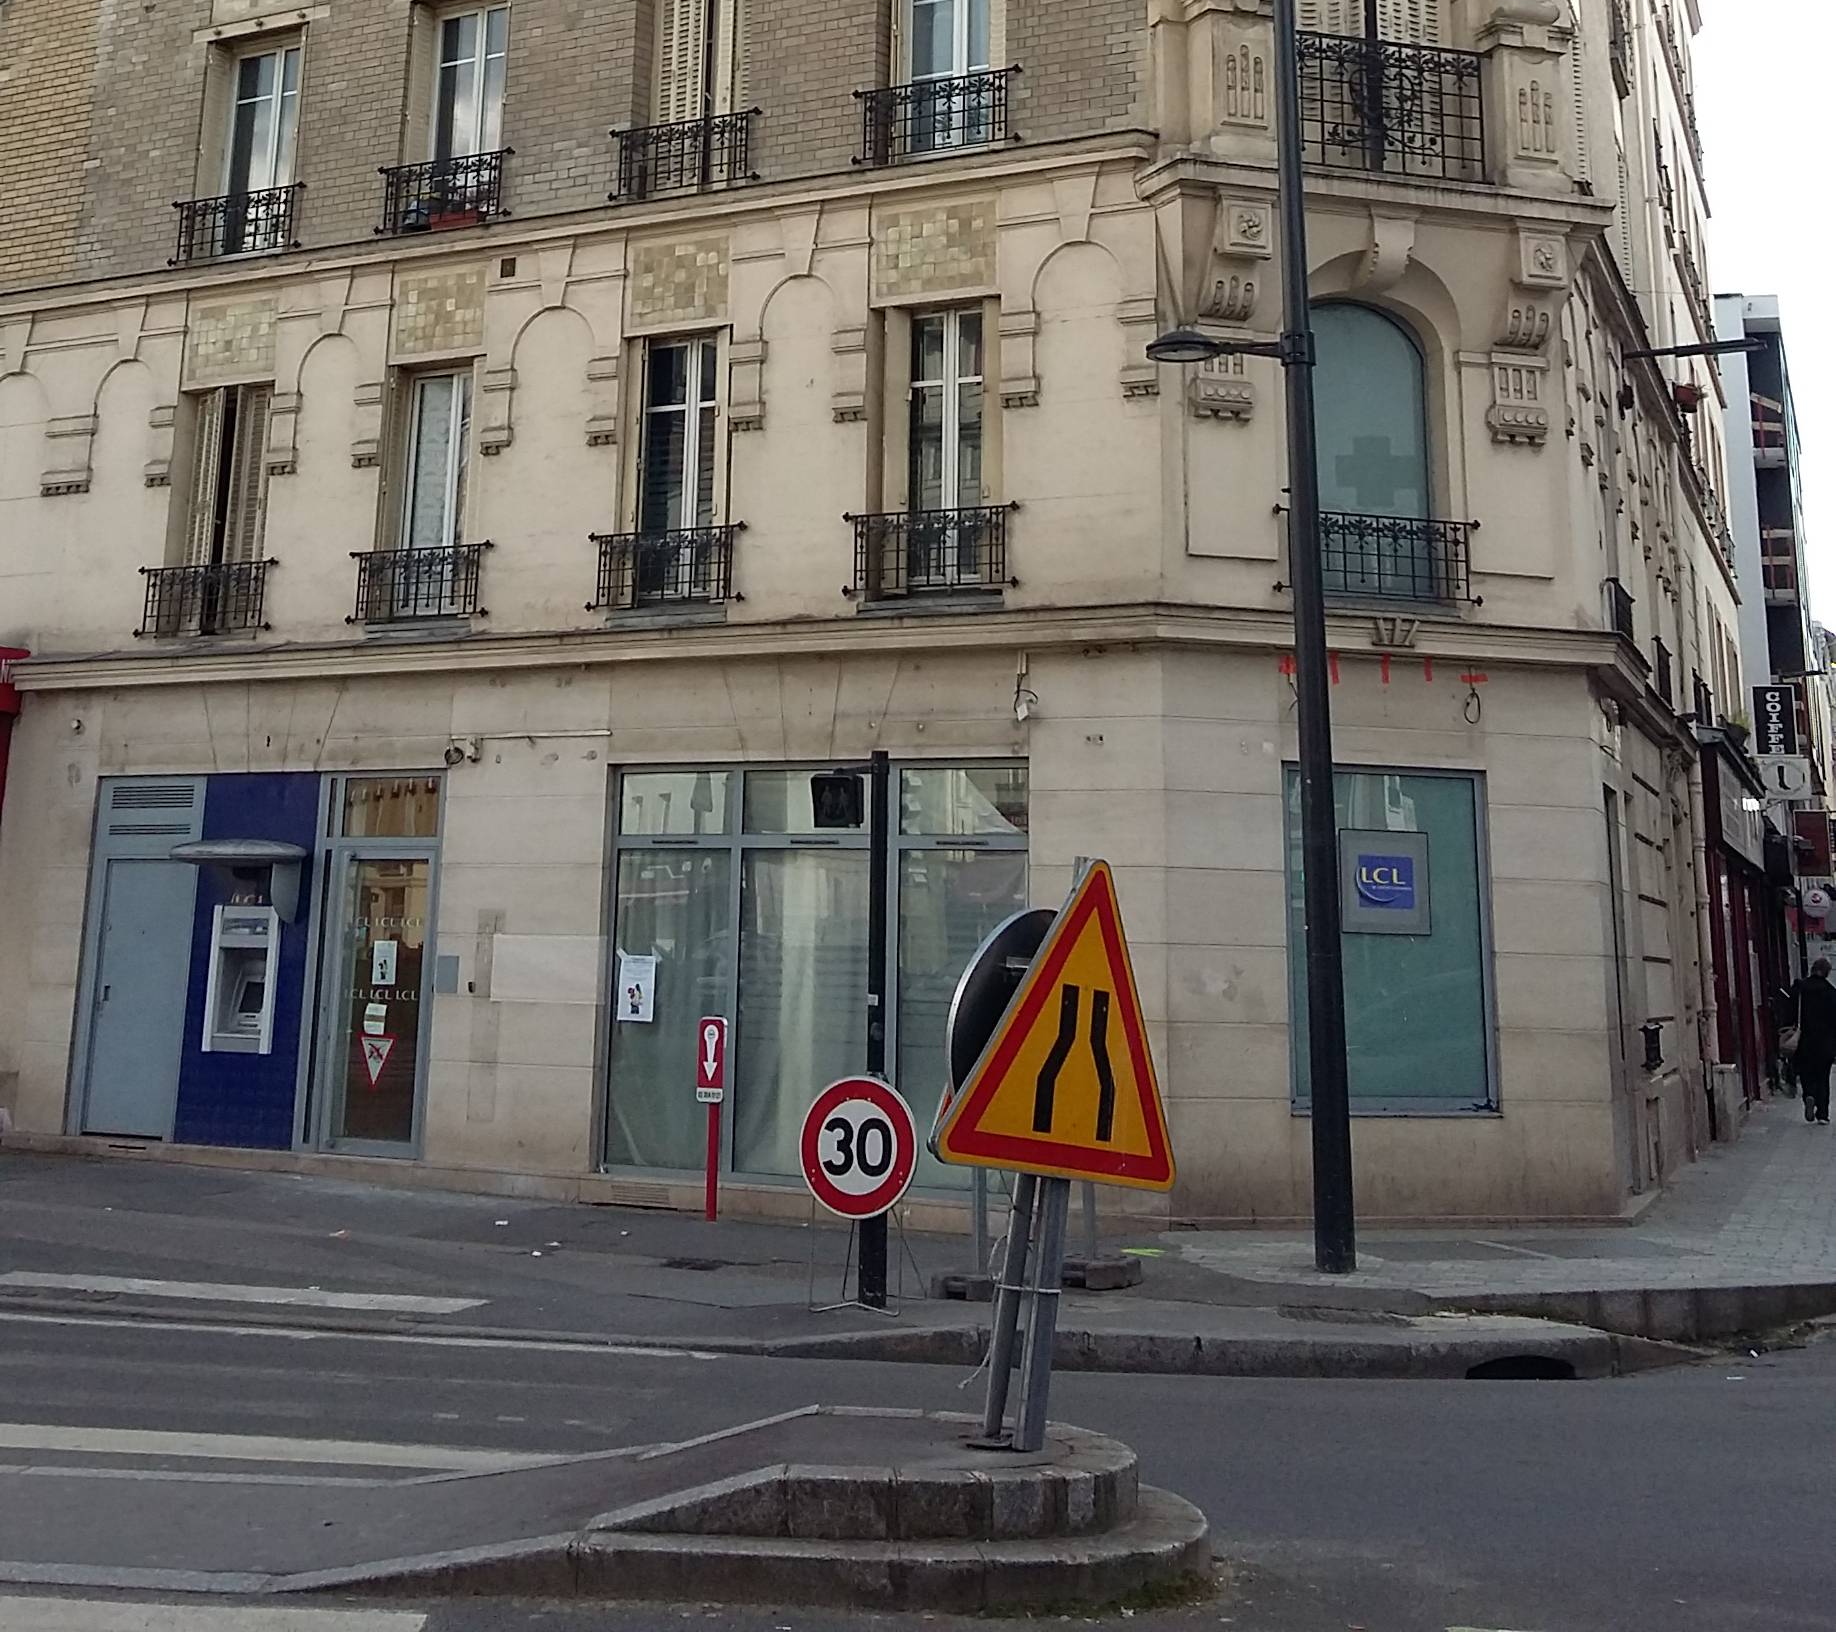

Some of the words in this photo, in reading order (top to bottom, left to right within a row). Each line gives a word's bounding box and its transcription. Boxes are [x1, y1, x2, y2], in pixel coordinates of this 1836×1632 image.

[1765, 691, 1785, 755] COIFFE
[1361, 866, 1406, 885] LCL
[370, 989, 393, 1001] LCL
[396, 989, 418, 1001] LCL
[822, 1117, 893, 1177] 30
